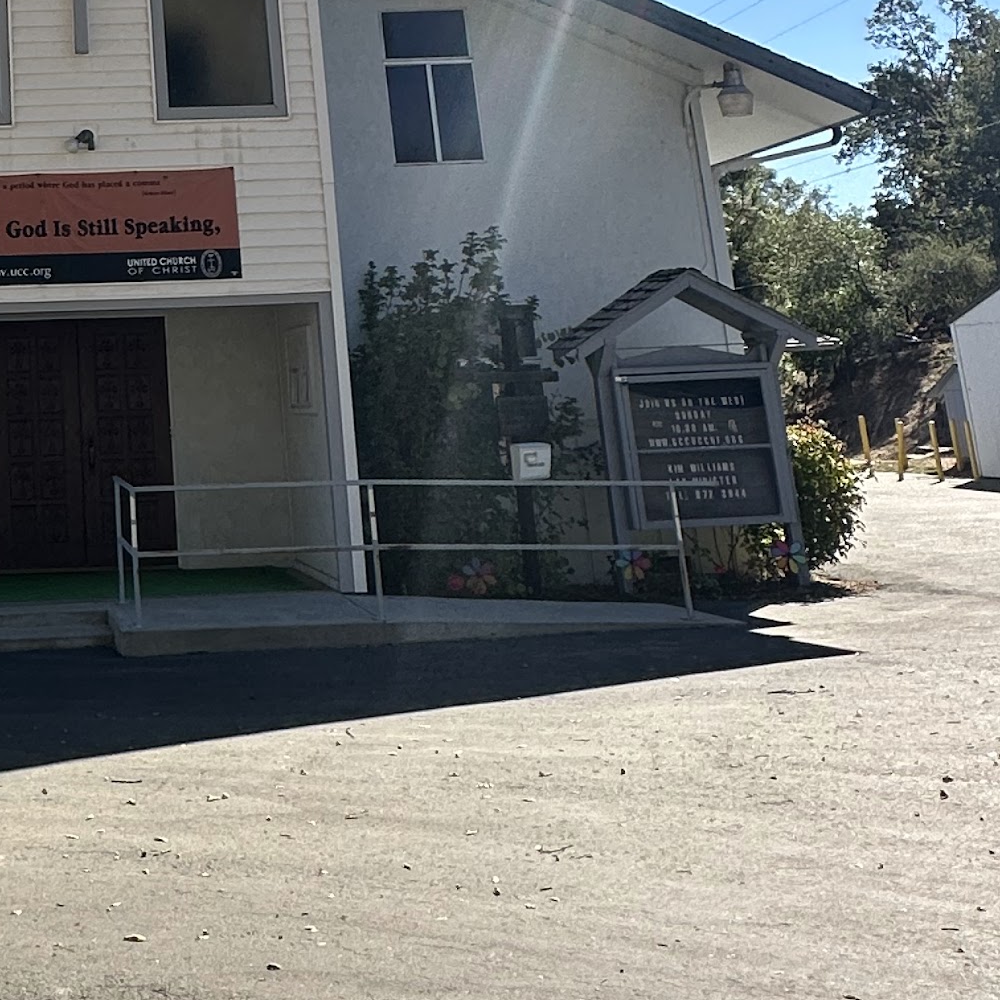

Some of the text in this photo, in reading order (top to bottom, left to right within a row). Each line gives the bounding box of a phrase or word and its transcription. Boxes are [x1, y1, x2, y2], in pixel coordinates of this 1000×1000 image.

[10, 182, 34, 191] period
[98, 180, 122, 189] placed
[5, 216, 221, 238] God Is Still Speaking,
[127, 256, 197, 267] UNITED CHURCH
[127, 266, 197, 276] OF CHRIST
[639, 398, 660, 408] JOIN
[664, 398, 677, 408] US
[698, 397, 716, 406] THE
[675, 410, 711, 420] SUNDAY
[690, 462, 735, 473] WILLIAMS
